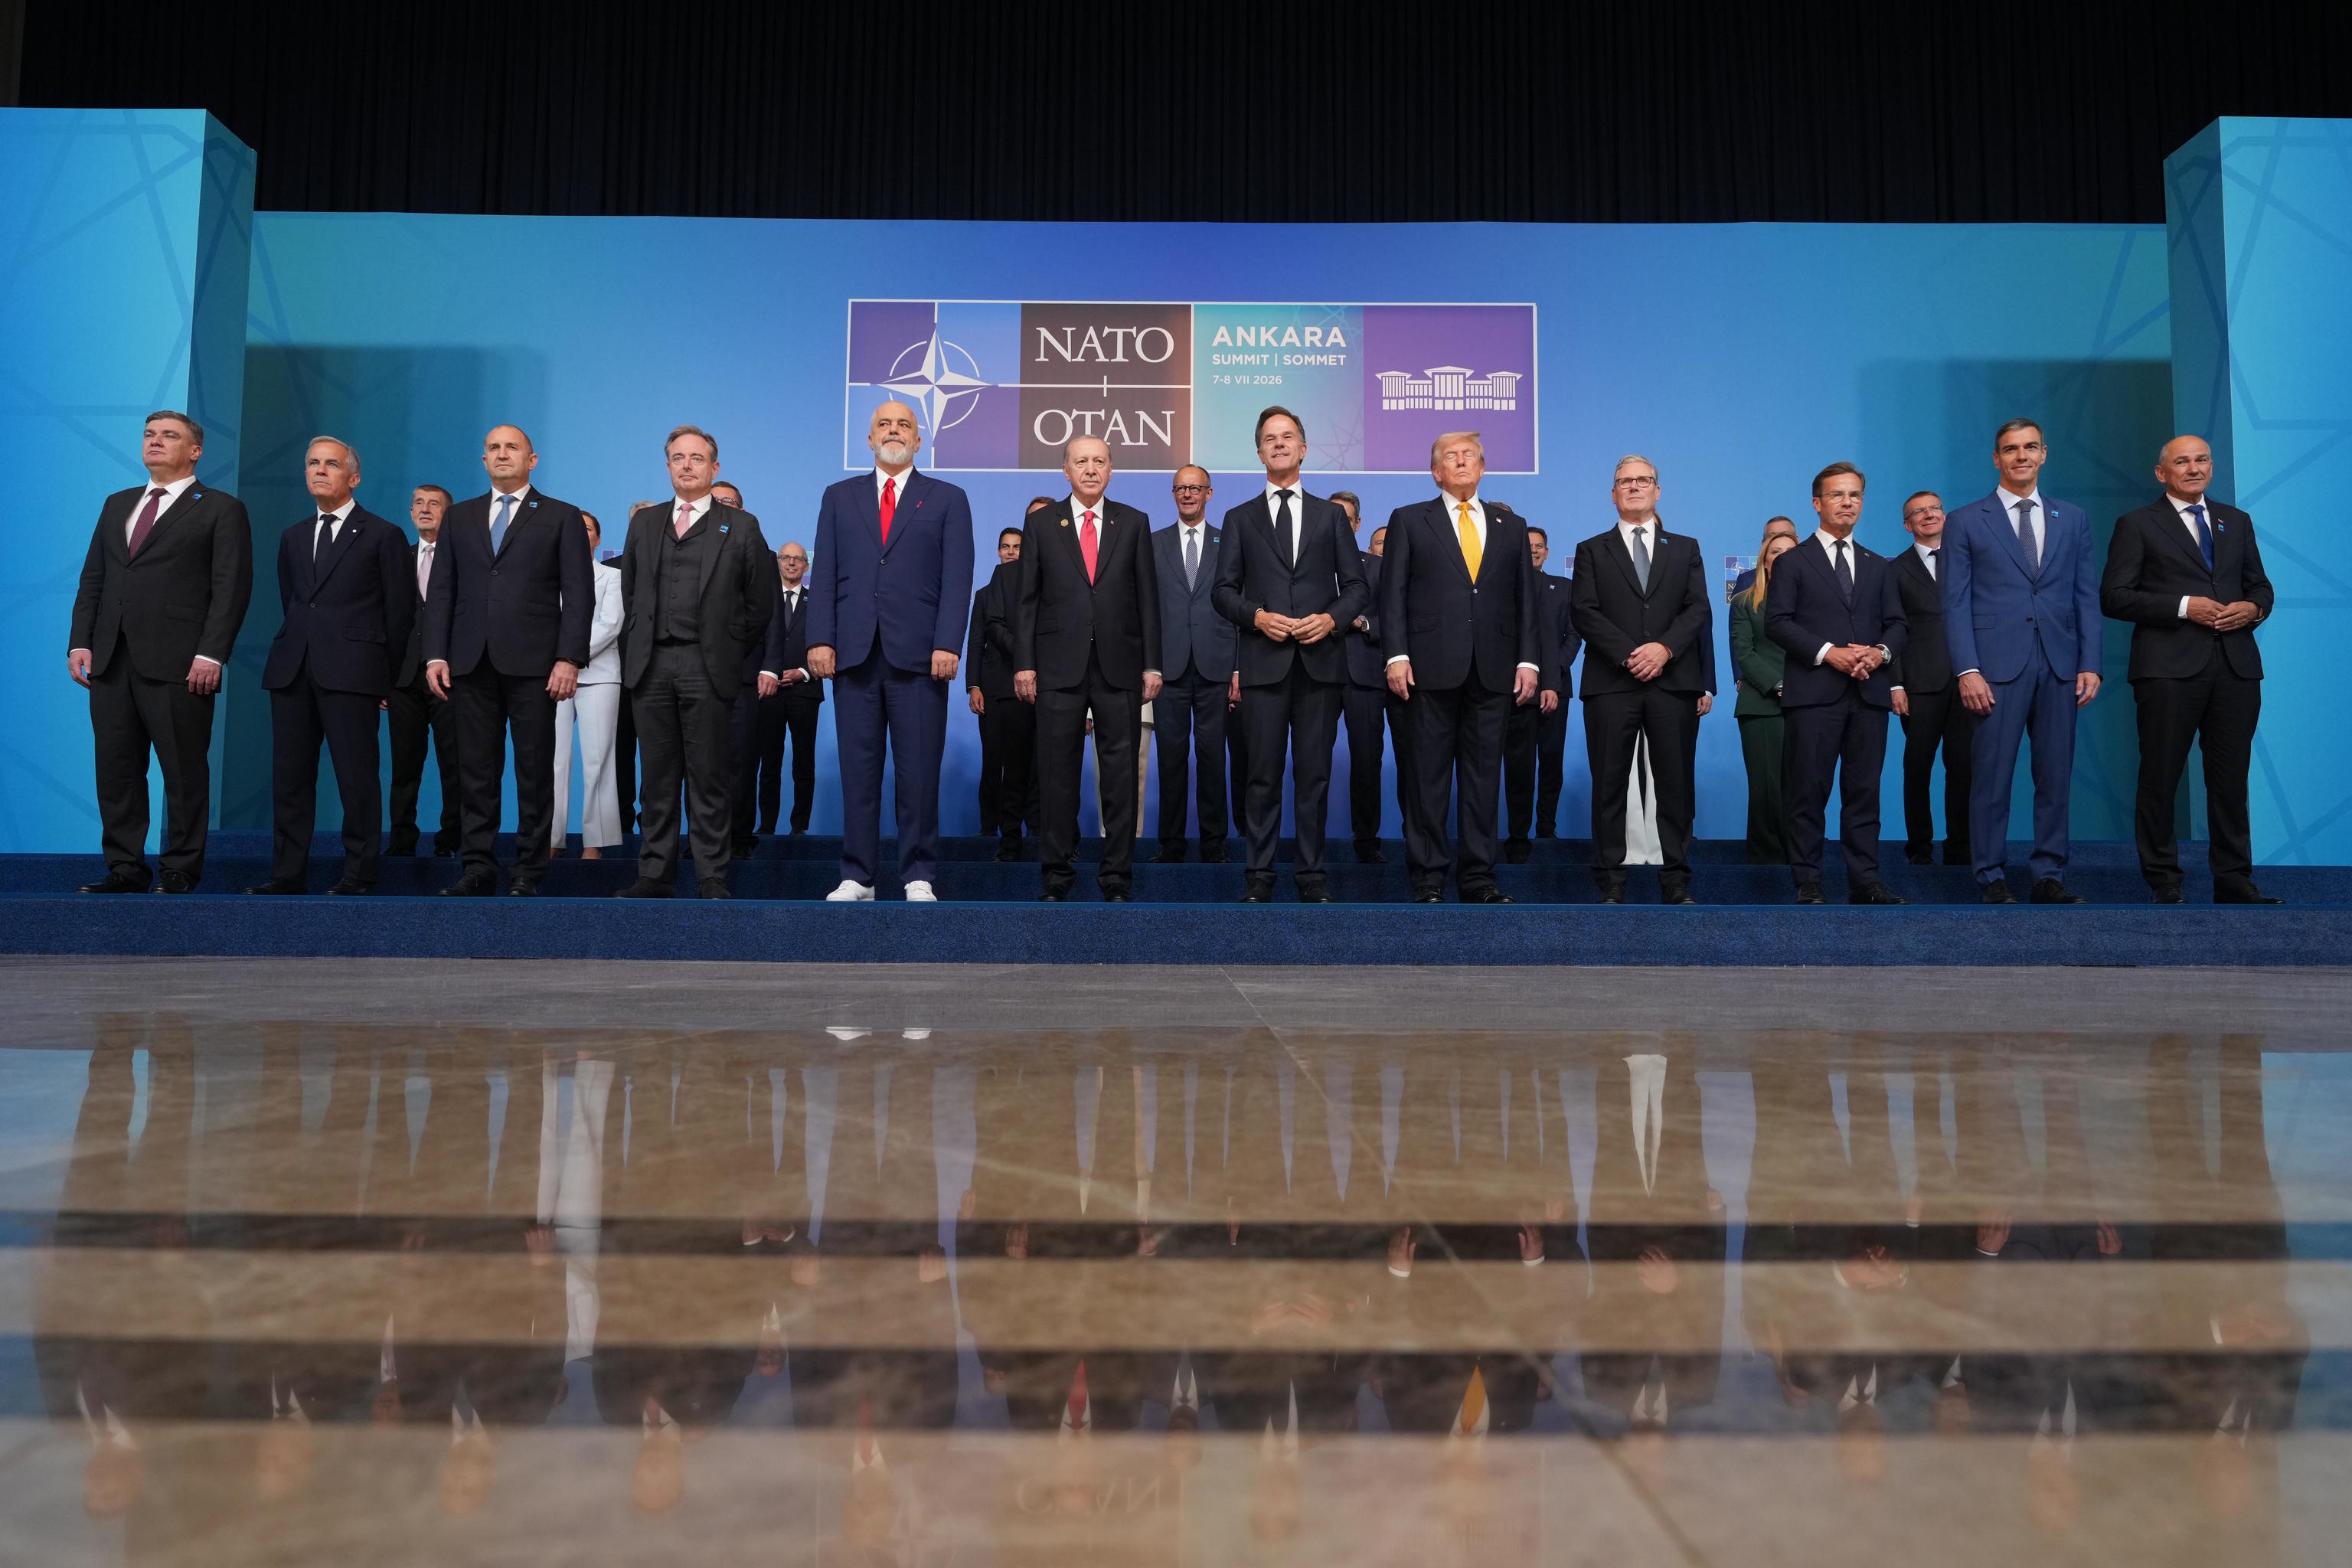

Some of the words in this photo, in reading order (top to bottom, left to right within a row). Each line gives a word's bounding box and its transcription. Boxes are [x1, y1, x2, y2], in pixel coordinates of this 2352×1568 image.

[1034, 325, 1174, 363] NATO
[1212, 326, 1347, 348] ANKARA
[1212, 353, 1269, 366] SUMMIT
[1283, 354, 1347, 367] SOMMET
[1212, 374, 1231, 385] 7-8
[1234, 374, 1250, 385] VII
[1253, 374, 1282, 385] 2026
[1034, 408, 1176, 446] OTAN
